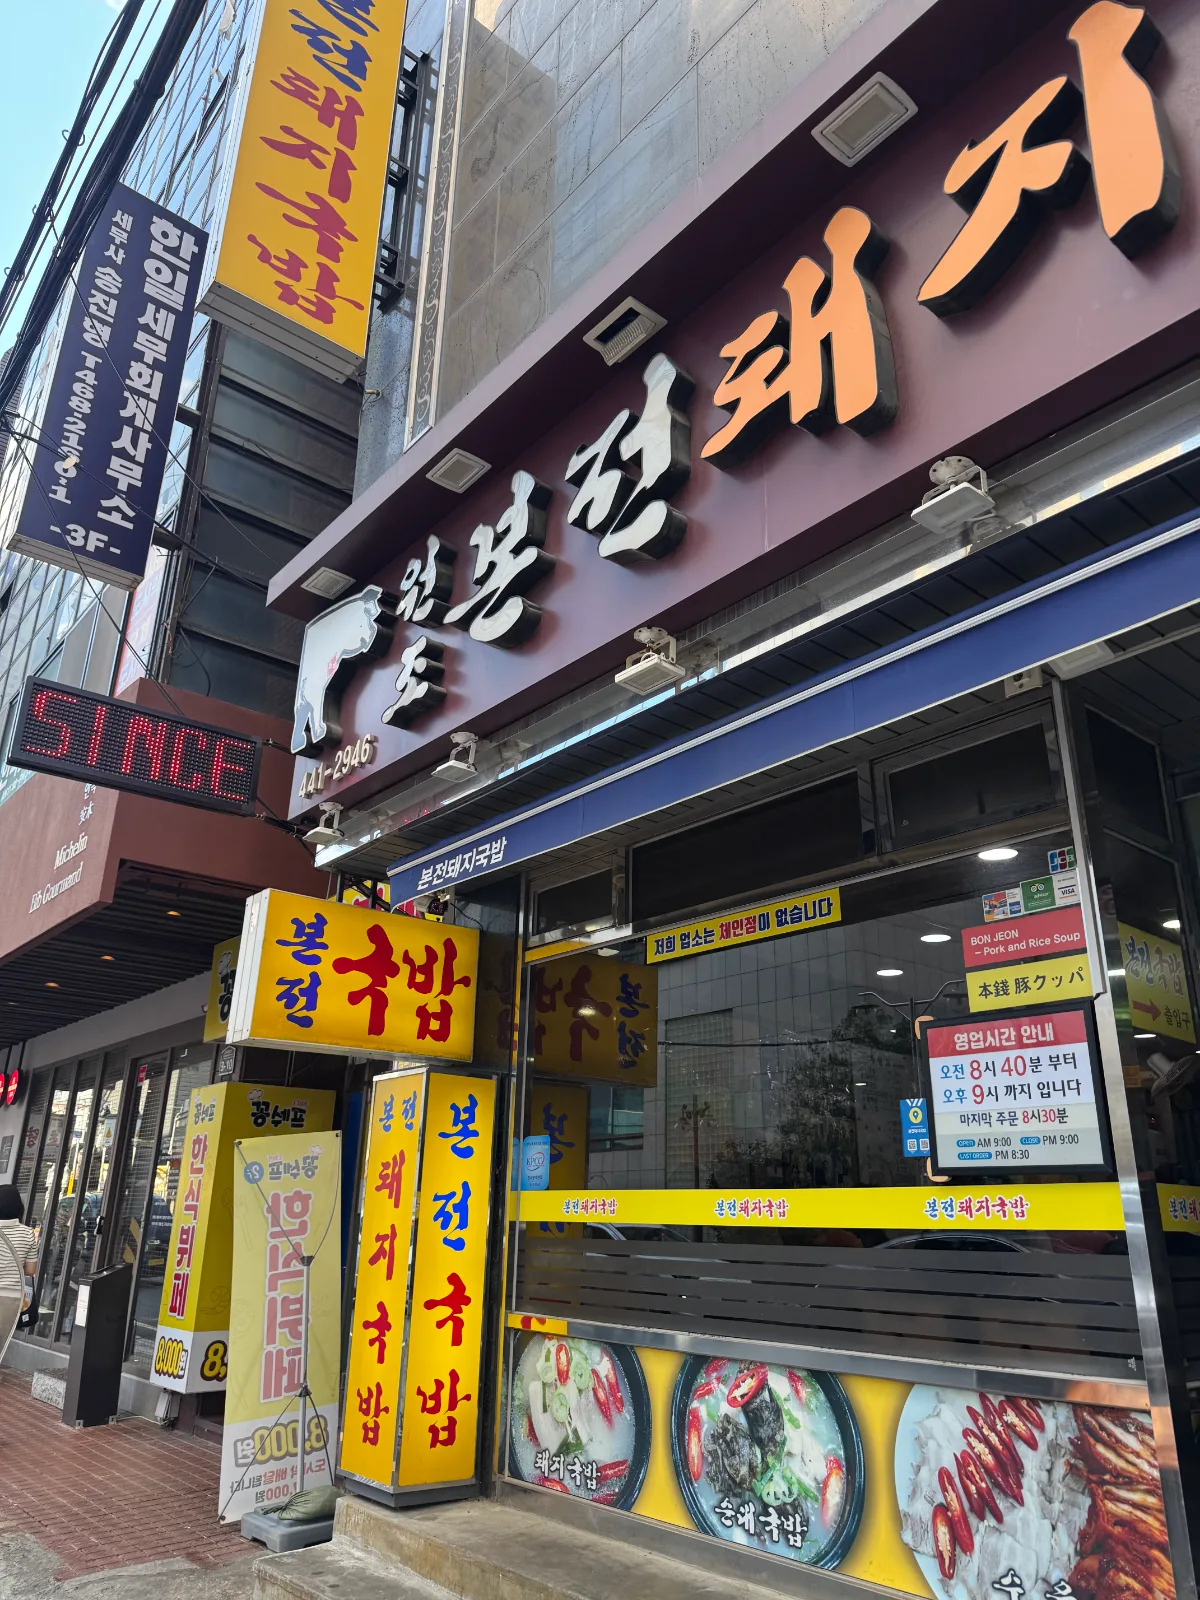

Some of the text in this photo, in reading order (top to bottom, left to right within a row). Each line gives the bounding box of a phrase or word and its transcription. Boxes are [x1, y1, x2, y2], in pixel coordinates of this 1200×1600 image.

[26, 690, 251, 802] SINCE
[299, 733, 375, 798] 441-2946
[54, 832, 88, 870] Michelin
[416, 836, 508, 891] 본전돼지국밥
[29, 861, 84, 914] Bib Gourmand
[1061, 888, 1075, 896] VISA
[654, 896, 833, 956] 저희 업소는 체인점이 없습니다
[970, 929, 1019, 946] BON JEON
[984, 945, 1006, 956] Pork
[1008, 941, 1027, 952] and
[1029, 936, 1051, 948] Rice
[1054, 932, 1081, 944] Soup
[276, 912, 472, 1043] 본전 국밥
[954, 1022, 1055, 1051] 영업시간 안내
[940, 1063, 966, 1080] 오전
[969, 1059, 997, 1081] 8시
[1048, 1052, 1078, 1072] 부터
[943, 1078, 1082, 1105] 오후 9시 까지 입니다
[379, 1091, 418, 1132] 본전
[960, 1107, 1069, 1127] 마지막 주문 8시30분
[977, 1137, 992, 1148] AM
[993, 1136, 1012, 1148] 9:00
[1043, 1135, 1057, 1145] PM
[1059, 1134, 1079, 1145] 9:00
[995, 1150, 1009, 1160] PM
[1011, 1149, 1030, 1160] 8:30
[562, 1197, 618, 1217] 본전돼지국밥
[714, 1197, 789, 1220] 본전돼지국밥
[924, 1195, 1030, 1220] 본전돼지국밥
[169, 1134, 208, 1318] 한식뷔페
[155, 1335, 189, 1380] 8,000원
